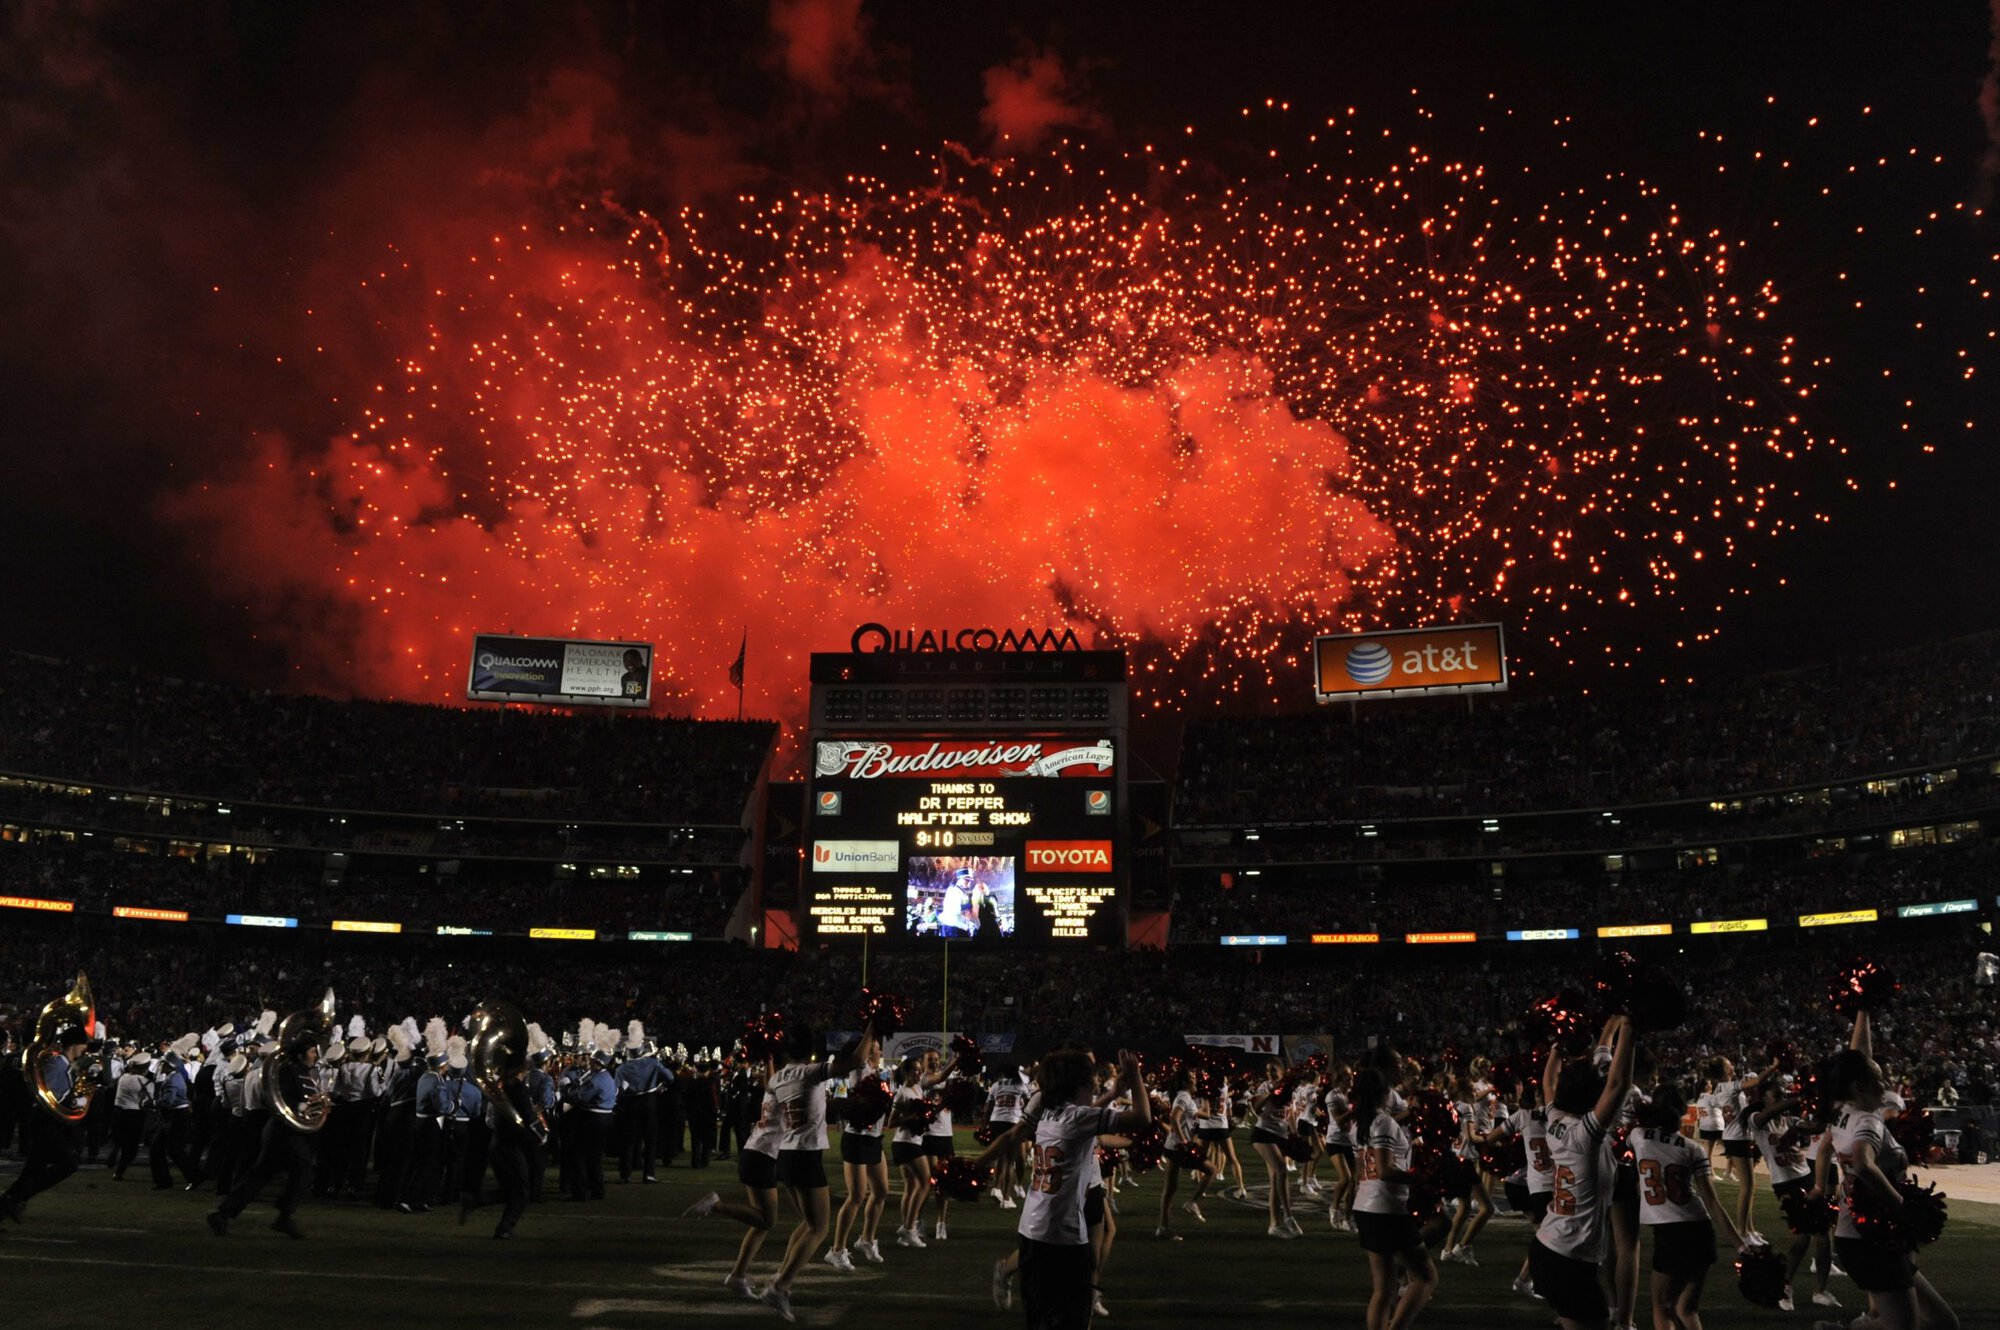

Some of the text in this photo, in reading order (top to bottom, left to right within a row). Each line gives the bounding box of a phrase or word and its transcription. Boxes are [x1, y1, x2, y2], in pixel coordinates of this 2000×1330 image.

[568, 648, 621, 658] PALOMAR
[1402, 641, 1478, 674] at&t
[479, 653, 558, 670] QUALCOMM
[898, 660, 1064, 671] STADIUM
[567, 666, 621, 677] HEALTH
[843, 740, 1041, 779] Budweiser
[1044, 751, 1111, 772] American Lager
[930, 783, 995, 794] THANKS TO
[919, 797, 1005, 809] DR PEPPER
[897, 812, 1031, 825] HALFTIME SHOW
[916, 831, 953, 847] 9:10
[835, 851, 897, 863] UnionBank
[1029, 849, 1109, 865] TOYOTA
[1025, 887, 1115, 896] THE PACIFIC LIFE
[37, 900, 73, 911] FARGO
[810, 907, 857, 915] HERCULES
[849, 916, 884, 924] SCHOOL
[872, 925, 886, 934] CA
[1608, 925, 1662, 937] CYMER
[1312, 933, 1378, 943] WELLS FARGO
[1252, 1036, 1273, 1053] N
[1643, 1129, 1686, 1148] BGA
[1639, 1158, 1692, 1206] 36
